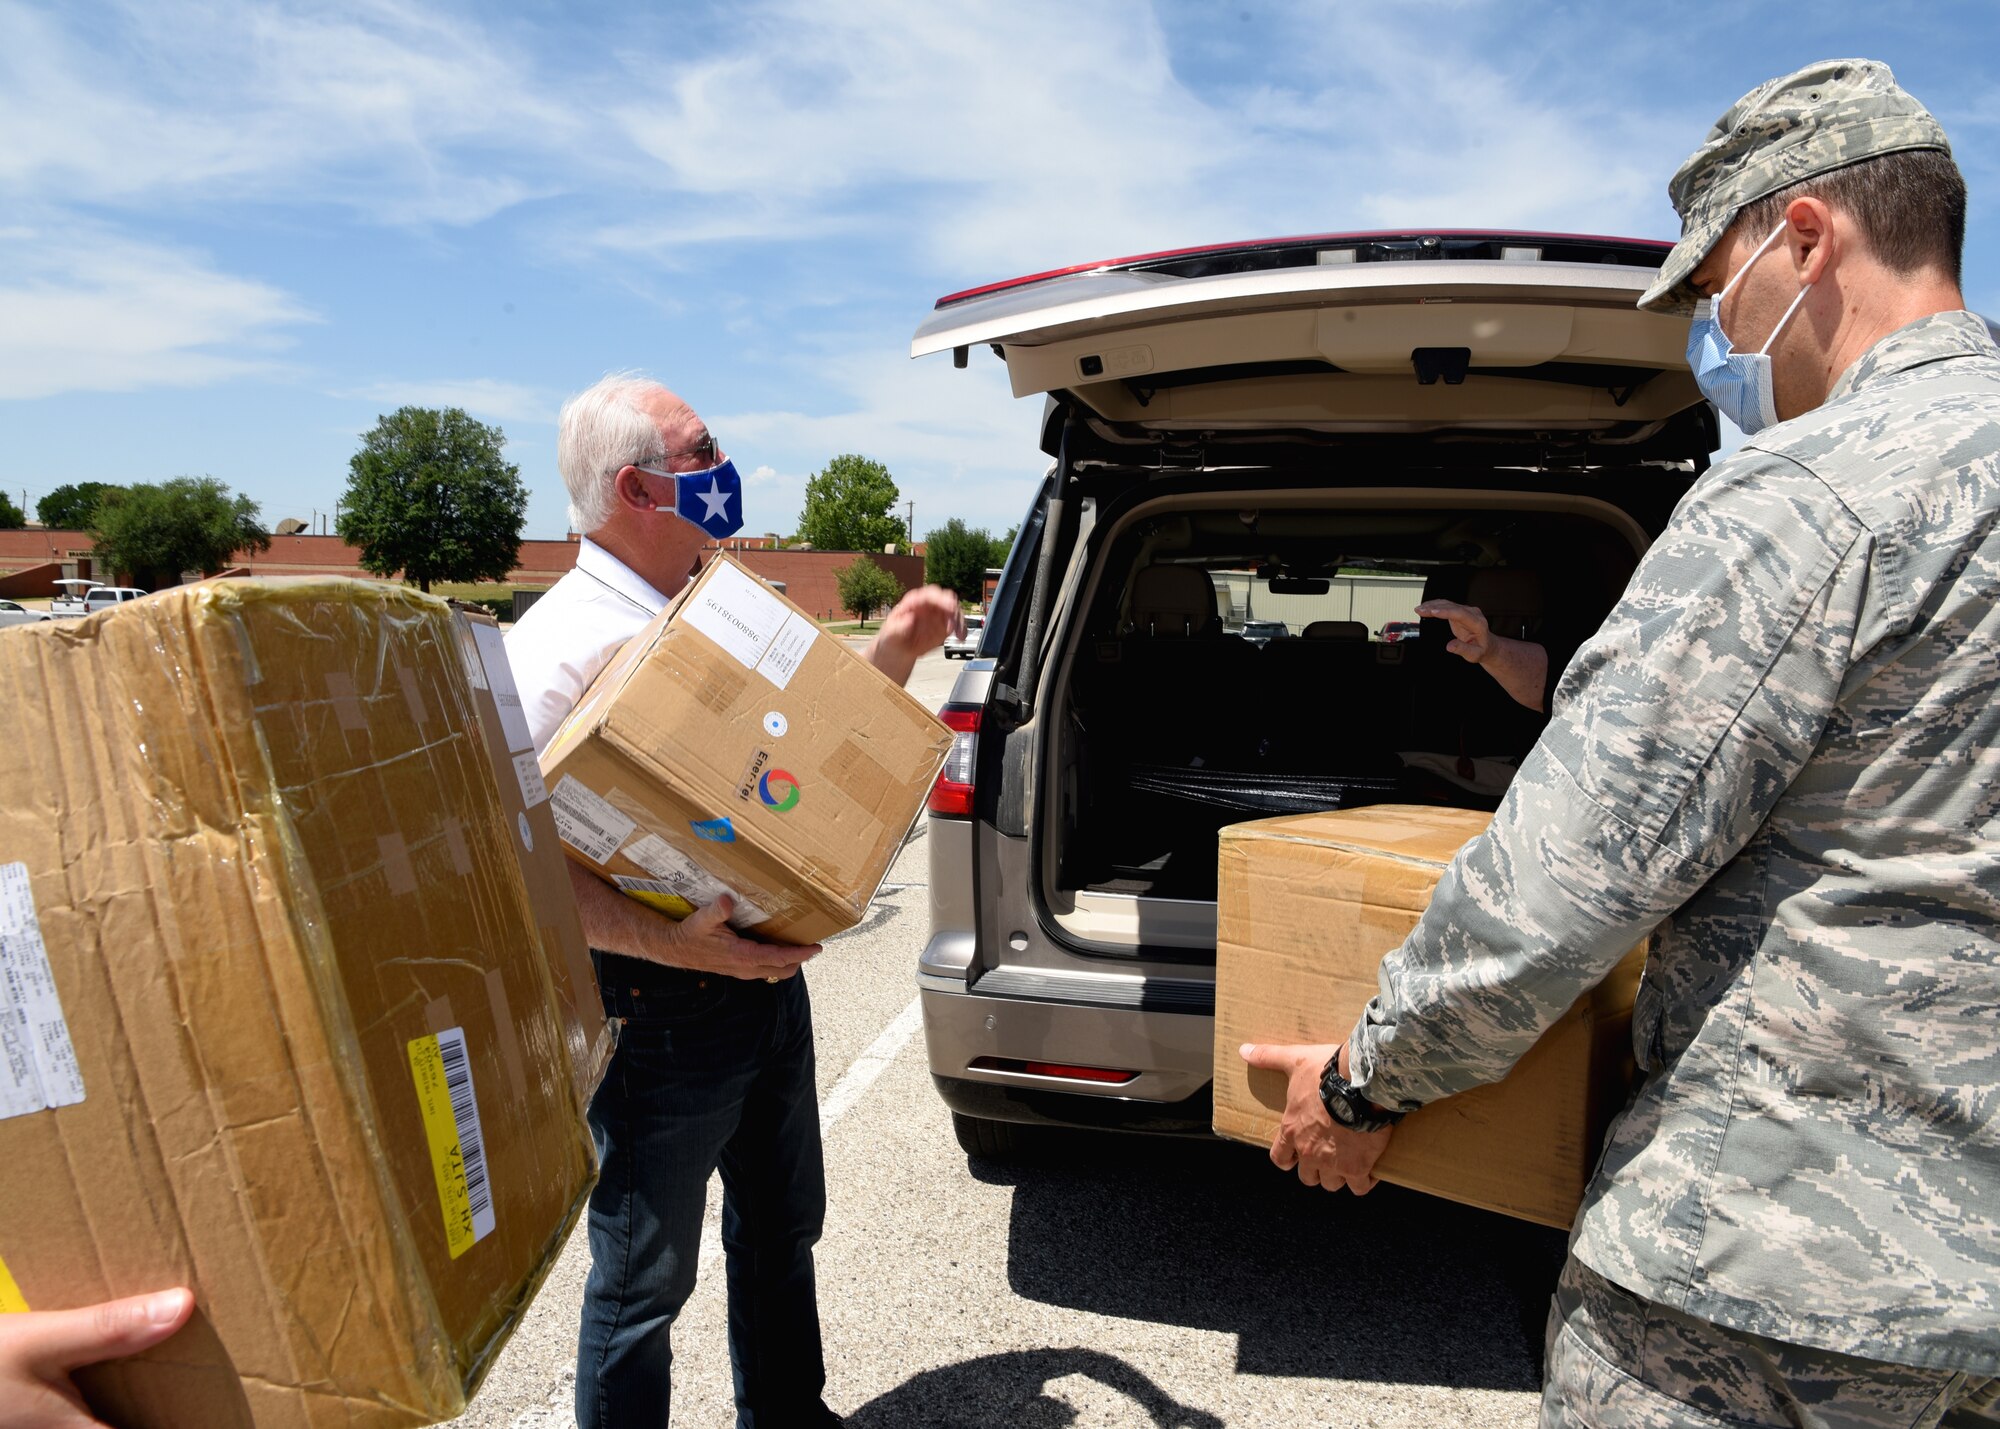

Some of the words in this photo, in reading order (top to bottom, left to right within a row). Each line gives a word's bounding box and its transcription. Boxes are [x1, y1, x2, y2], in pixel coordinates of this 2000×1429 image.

[704, 597, 760, 643] 9880038195
[739, 751, 768, 802] Ener-Tel
[450, 1144, 467, 1198] SJTA
[461, 1208, 472, 1236] XH
